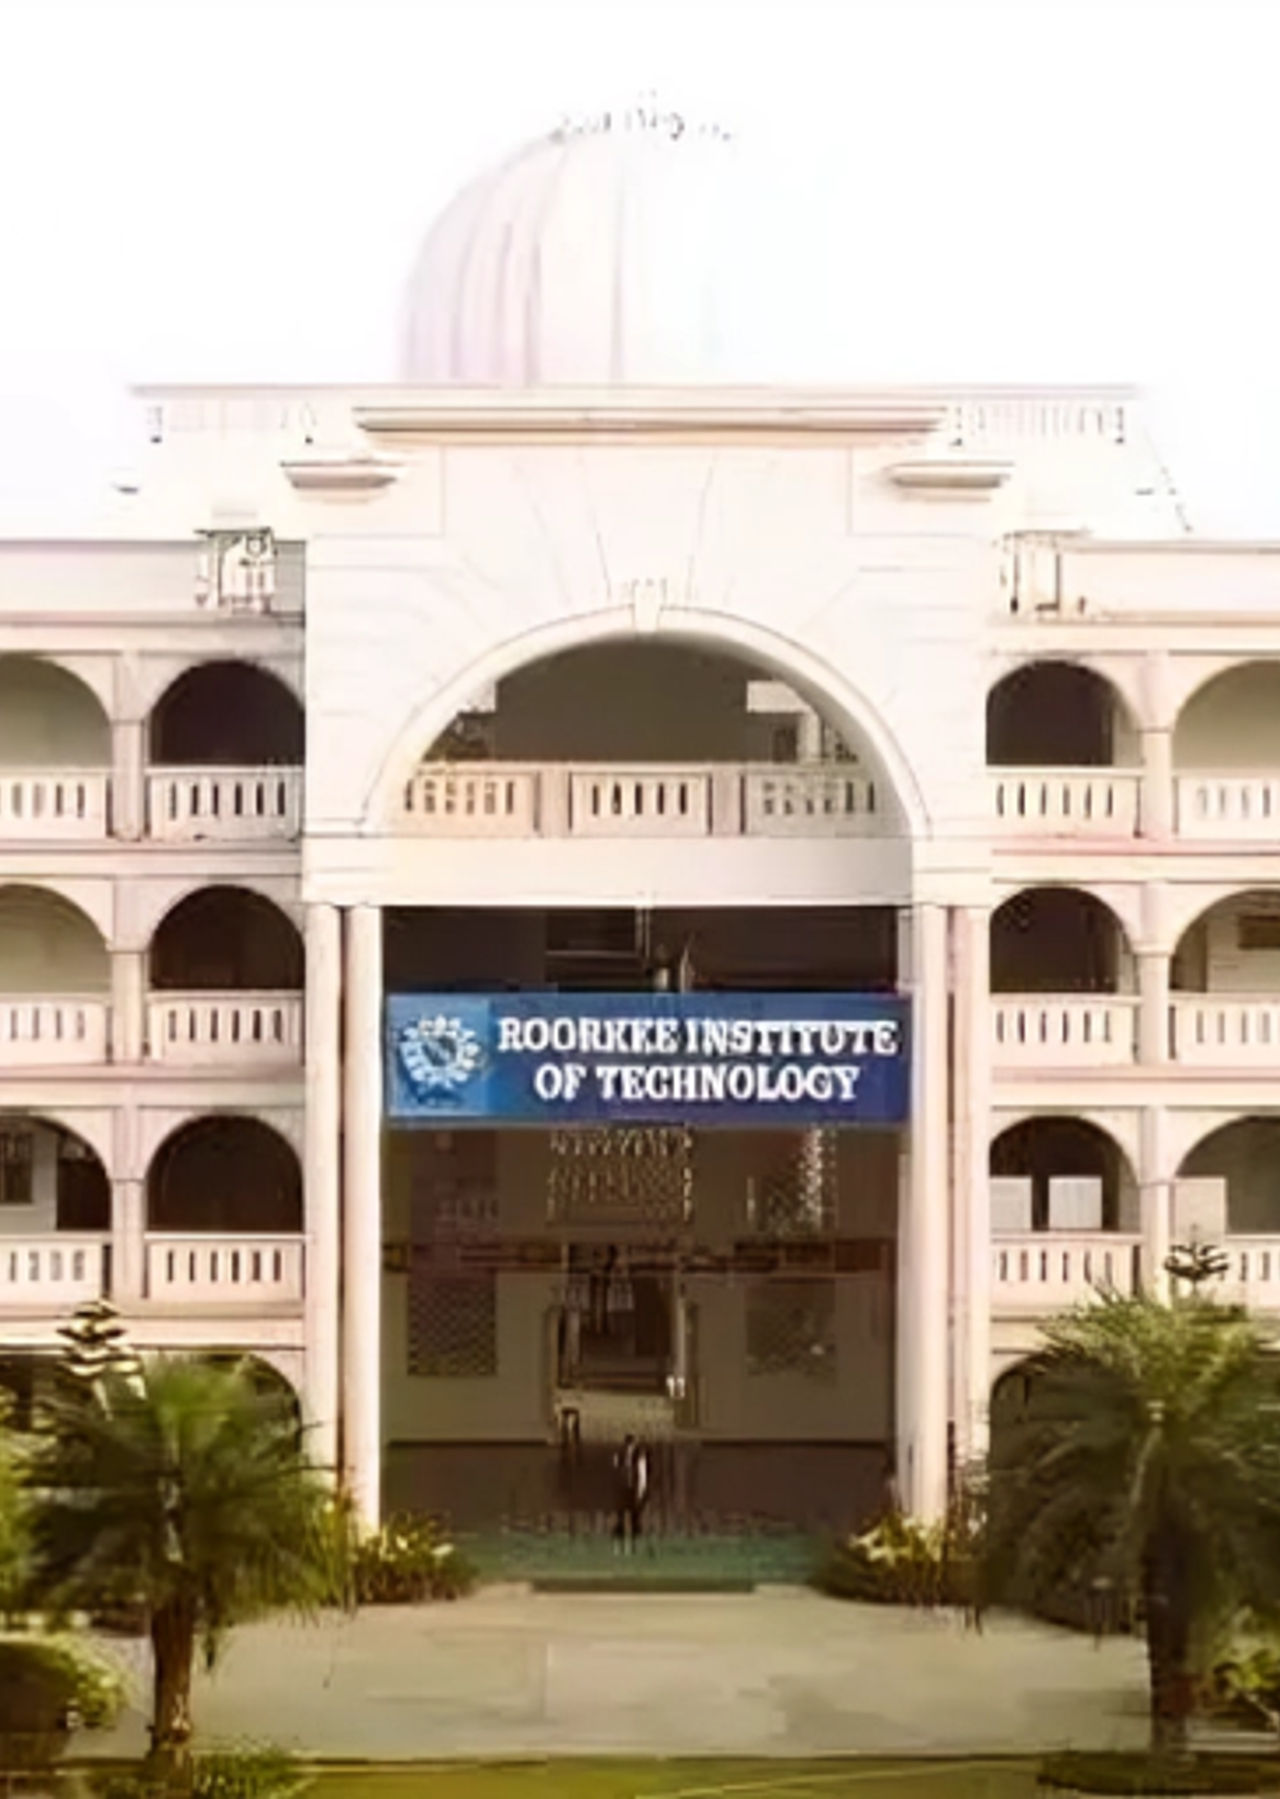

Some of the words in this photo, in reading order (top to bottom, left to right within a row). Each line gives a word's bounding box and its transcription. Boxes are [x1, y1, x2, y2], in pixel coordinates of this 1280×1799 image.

[685, 1018, 898, 1055] INSTITUTE
[534, 1063, 587, 1100] OF
[595, 1064, 861, 1100] TECHNOLOGY
